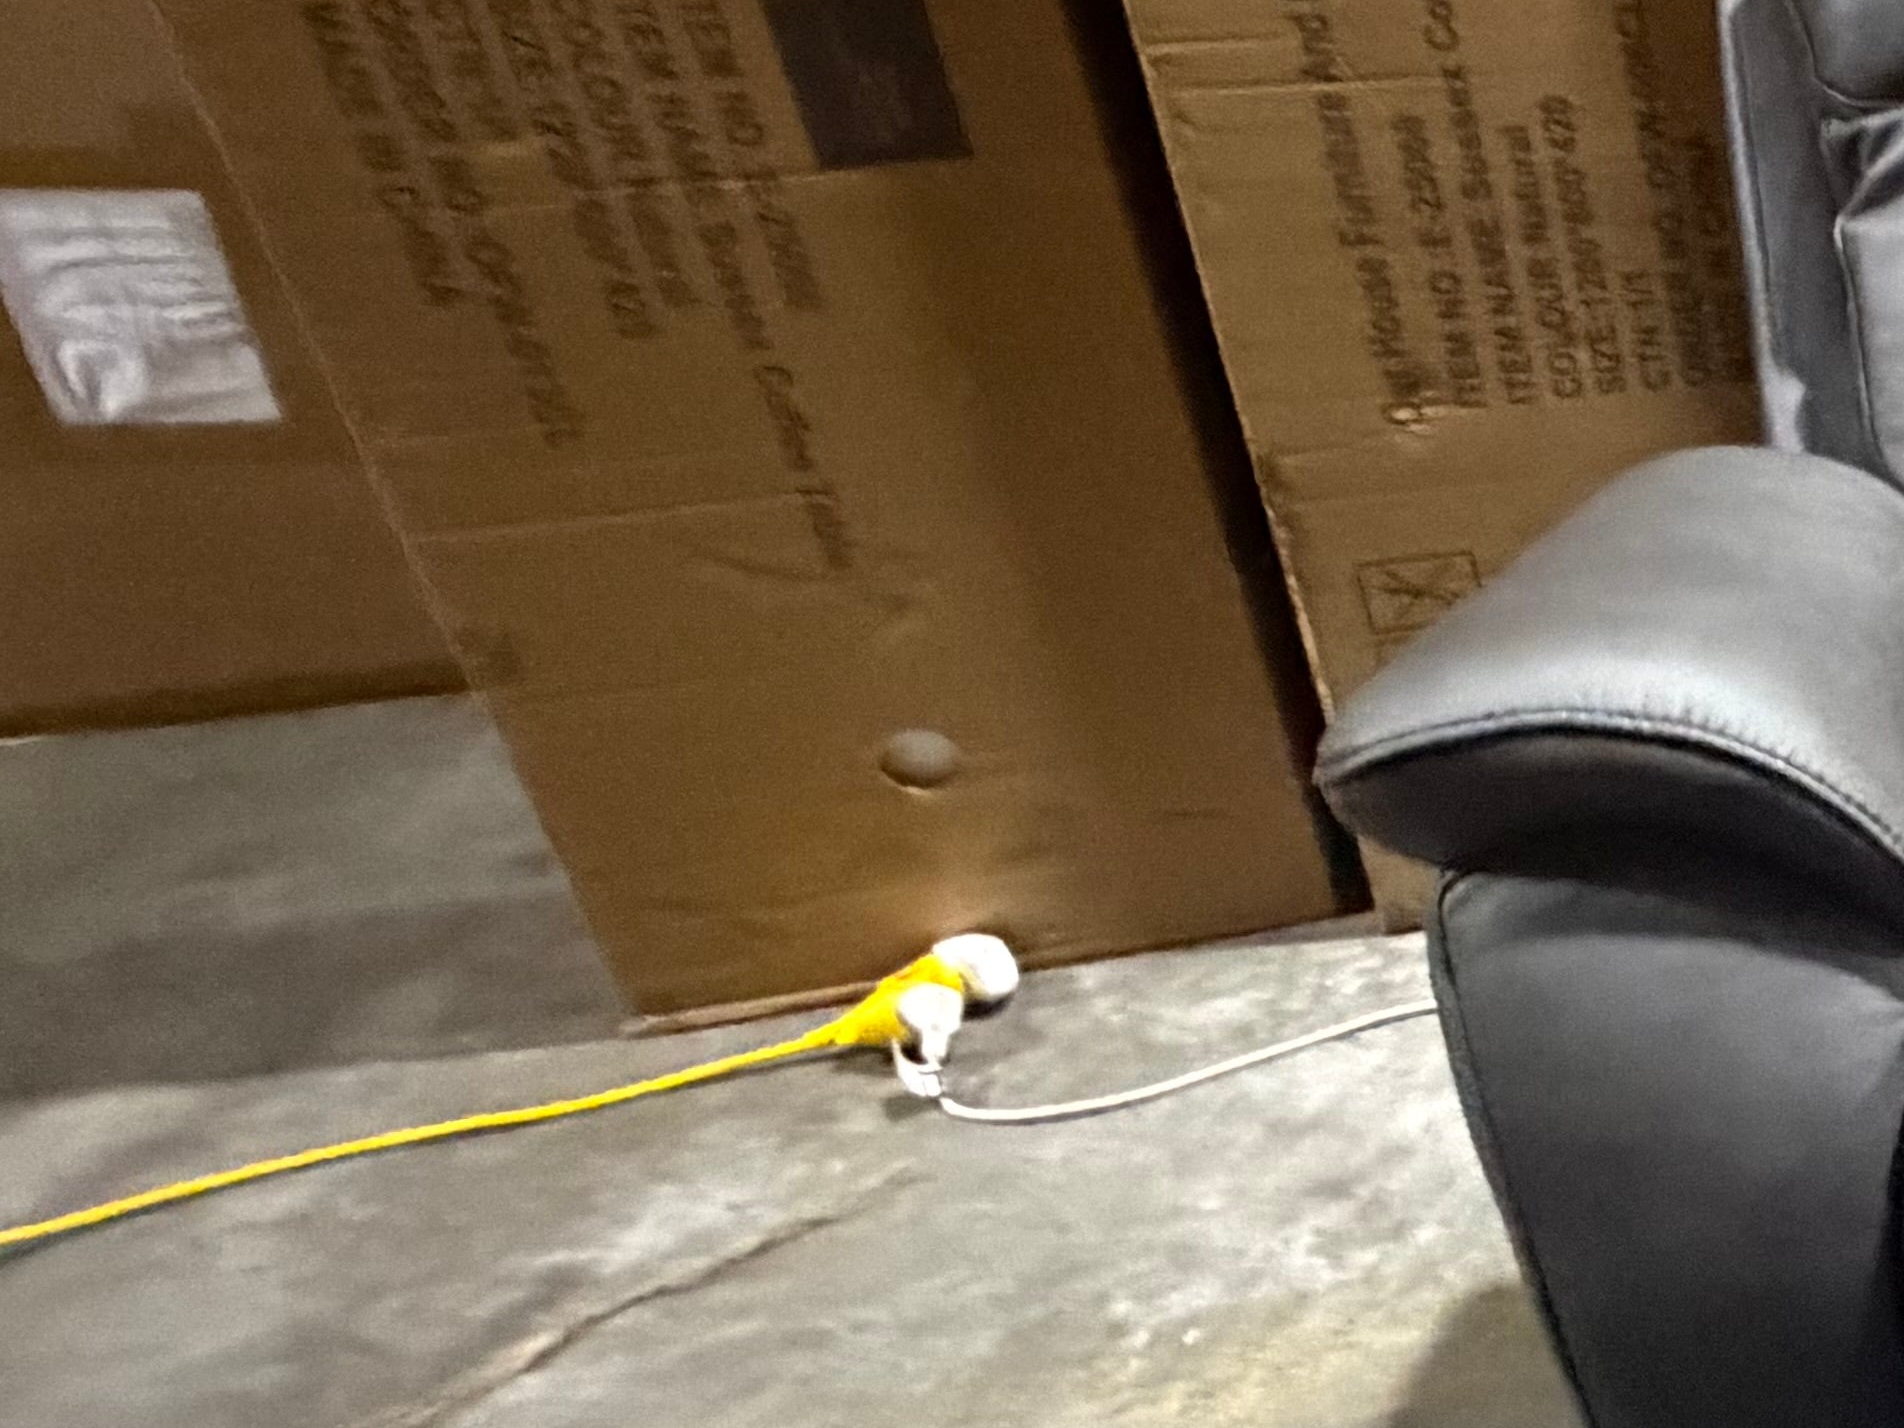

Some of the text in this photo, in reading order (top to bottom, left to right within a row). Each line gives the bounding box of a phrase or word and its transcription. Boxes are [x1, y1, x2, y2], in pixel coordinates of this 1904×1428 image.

[1315, 94, 1377, 245] Furniture
[1441, 66, 1491, 198] Sussex
[1493, 325, 1533, 404] ITEM
